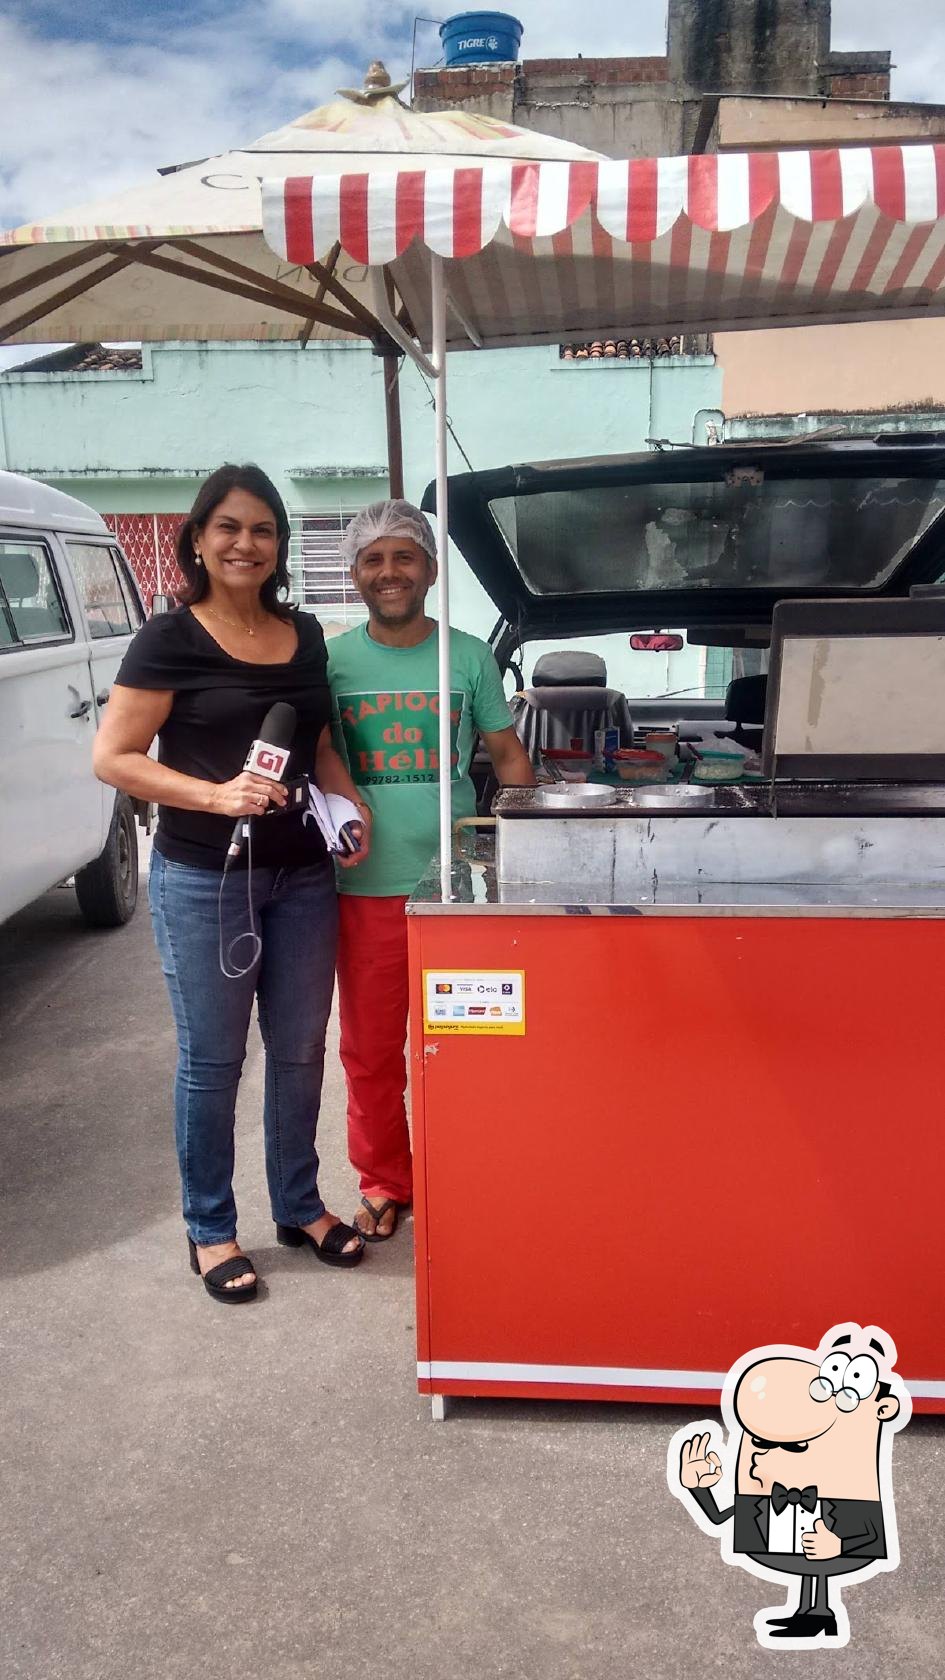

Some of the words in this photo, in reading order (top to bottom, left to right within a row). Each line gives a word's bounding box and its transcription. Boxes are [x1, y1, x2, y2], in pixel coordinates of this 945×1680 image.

[458, 38, 486, 50] TIGRE
[383, 722, 422, 744] do
[256, 750, 284, 774] G1
